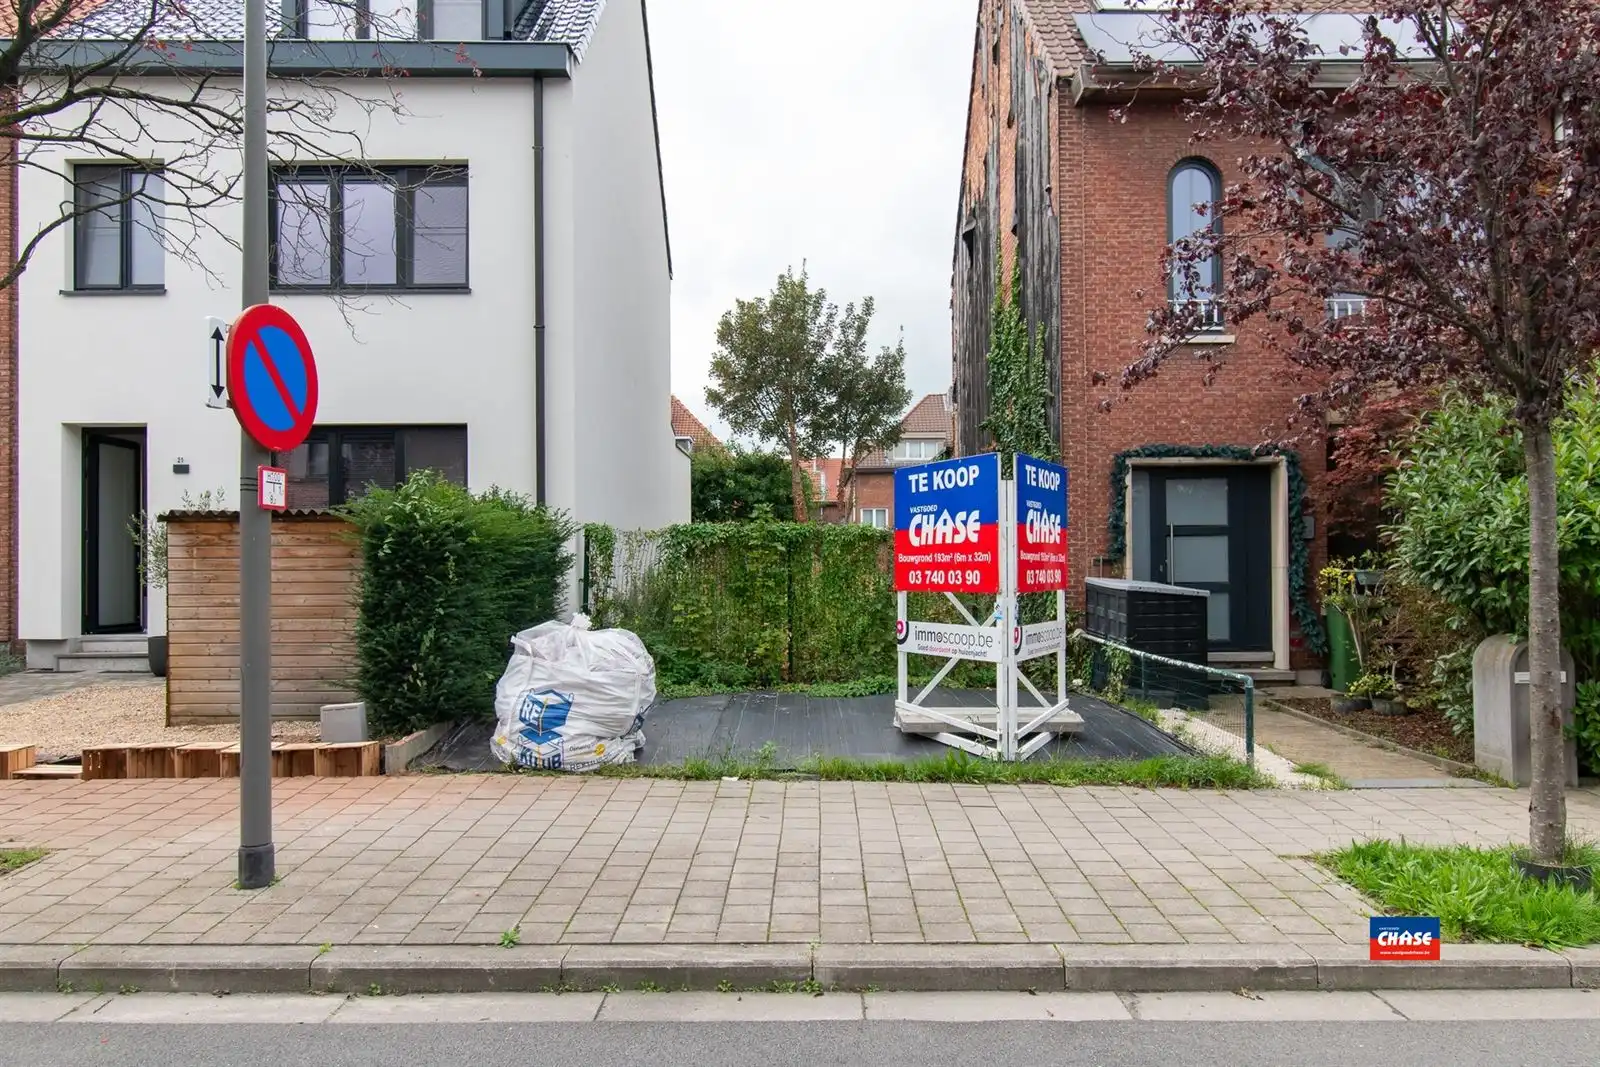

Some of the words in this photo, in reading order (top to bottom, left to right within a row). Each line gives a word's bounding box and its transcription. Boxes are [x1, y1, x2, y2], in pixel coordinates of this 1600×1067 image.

[908, 472, 929, 493] TE
[933, 465, 980, 490] KOOP
[1025, 464, 1036, 486] TE
[1038, 468, 1061, 492] KOOP
[909, 504, 938, 514] VASTGOED
[909, 509, 981, 547] CHASE
[1026, 509, 1061, 545] CHASE
[898, 553, 933, 565] Bouwgrond
[954, 552, 967, 565] (6m
[968, 554, 973, 562] x
[974, 552, 991, 564] 32m)
[908, 570, 922, 585] 03
[925, 570, 945, 585] 740
[948, 570, 962, 585] 03
[965, 569, 981, 585] 90
[1026, 569, 1035, 585] 03
[1035, 569, 1046, 585] 740
[1047, 569, 1054, 585] 03
[1054, 569, 1062, 583] 90
[914, 625, 993, 649] immoscoop.be
[521, 701, 542, 726] RE
